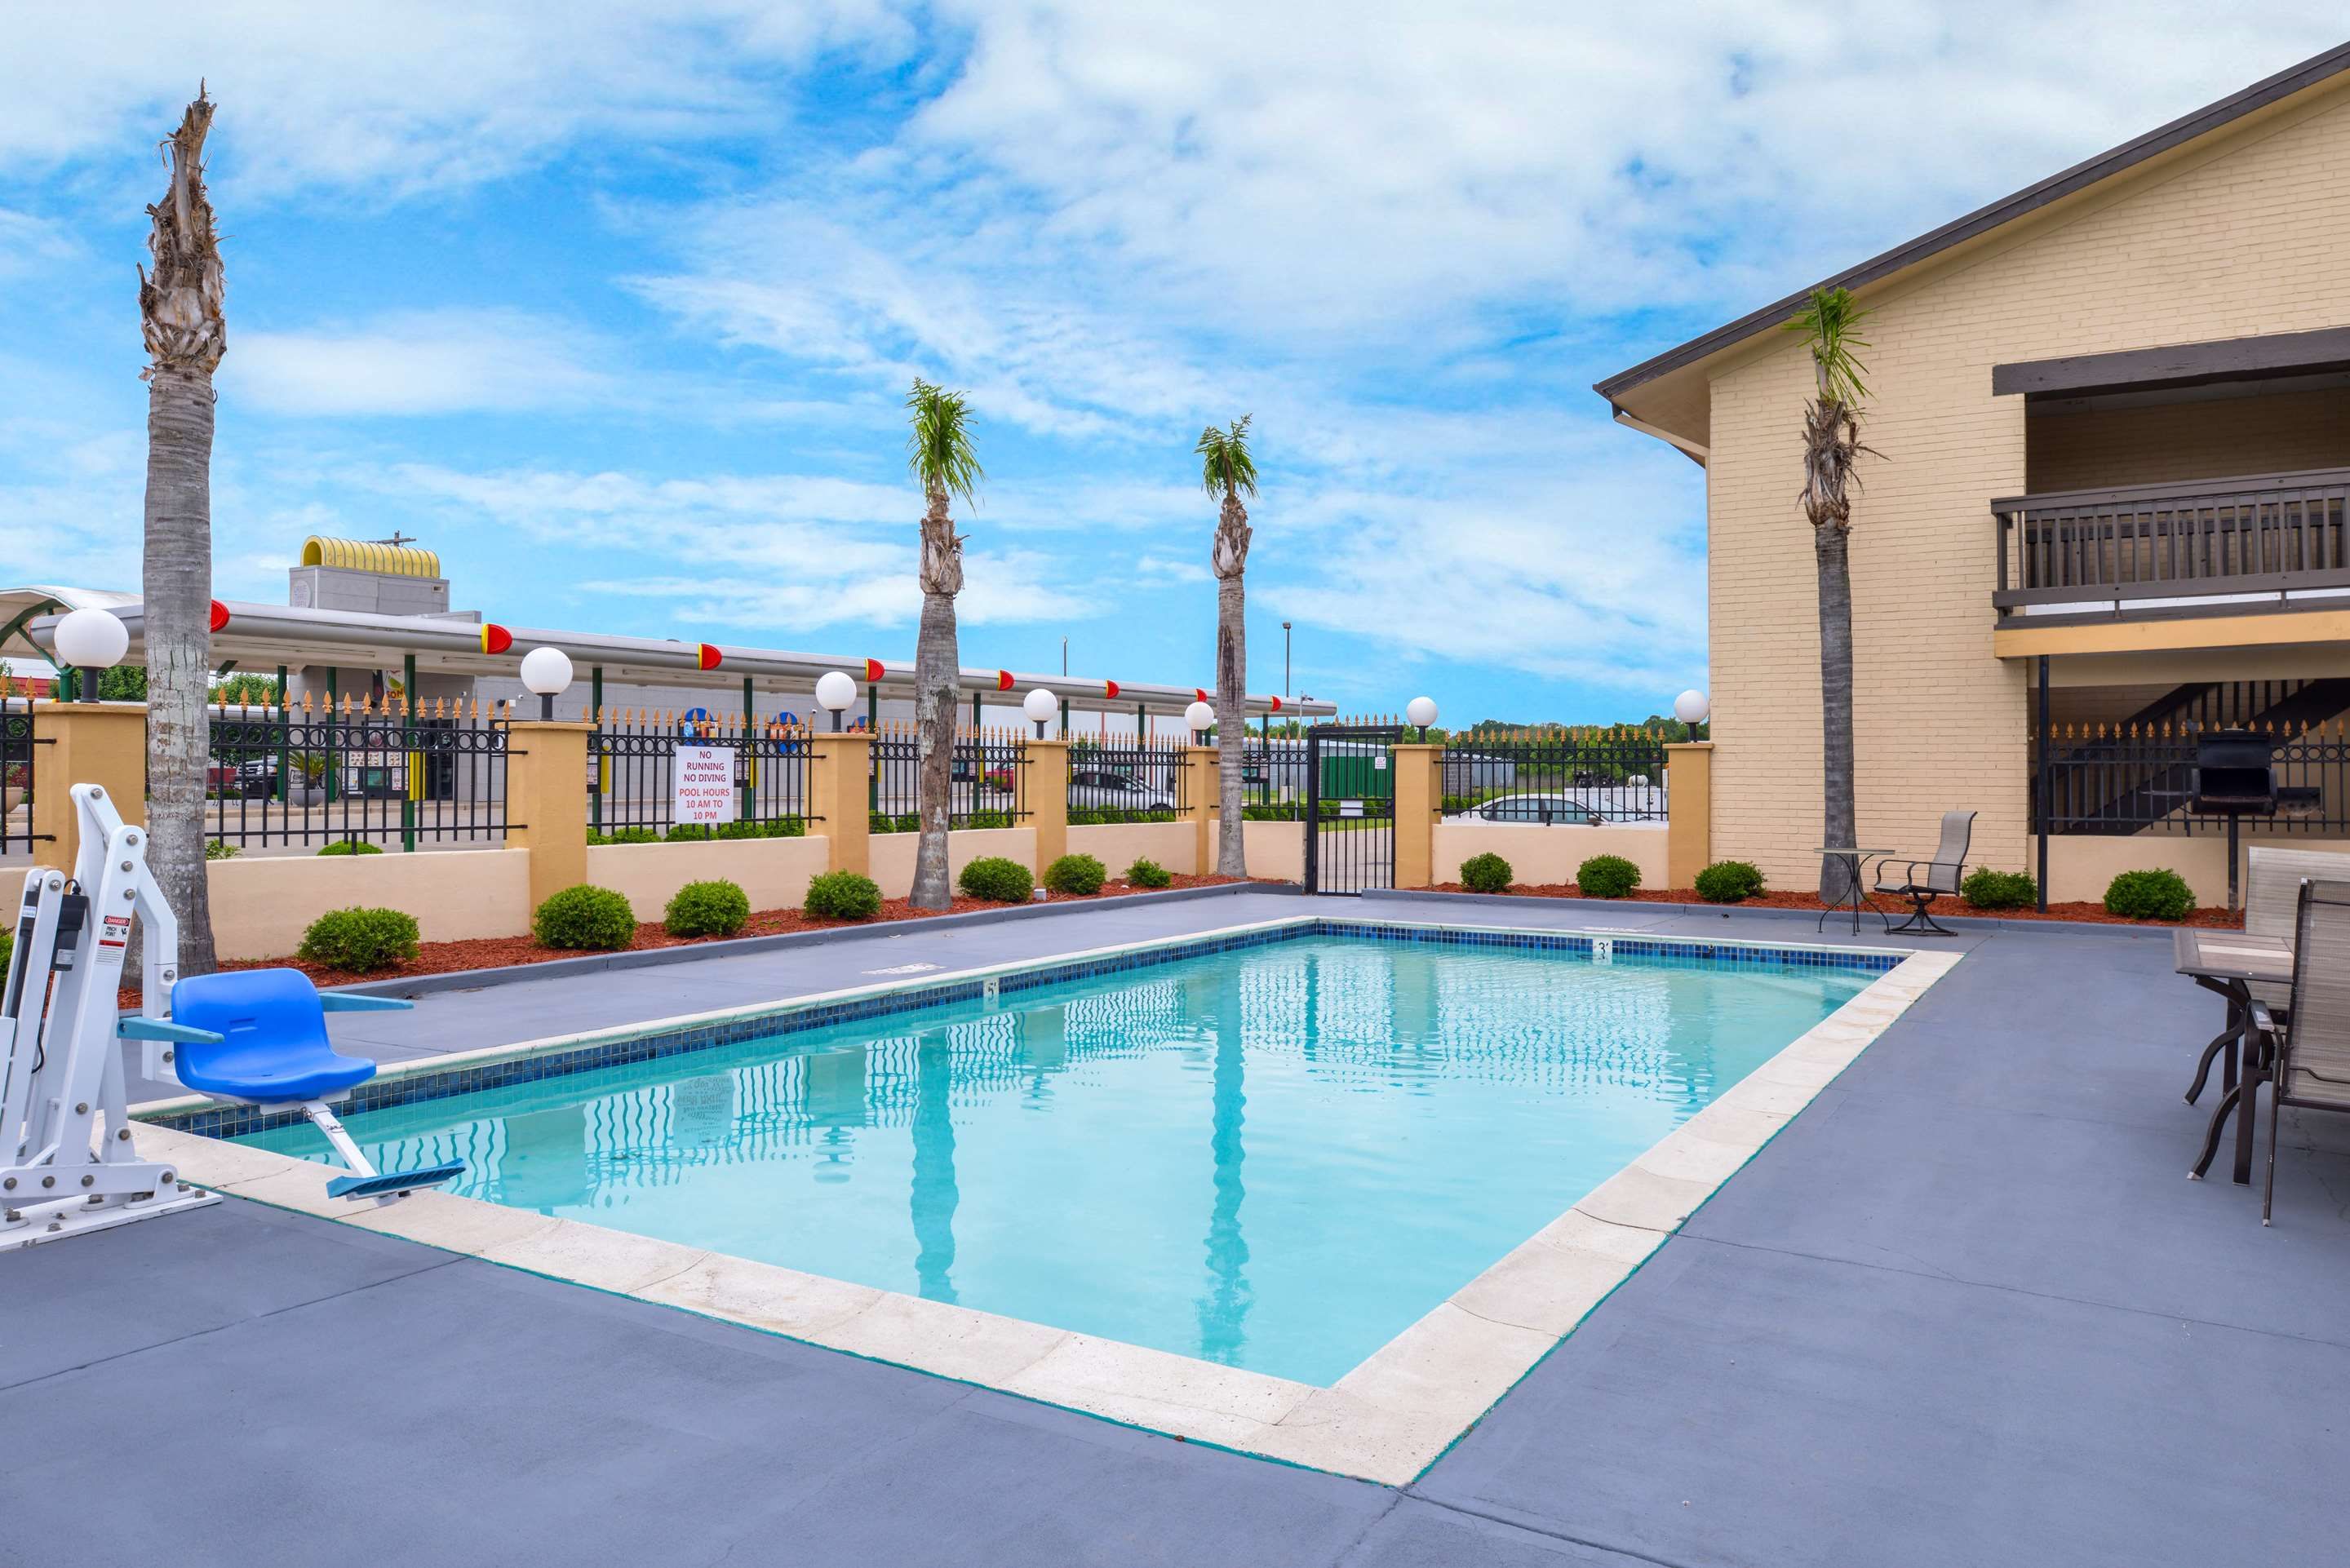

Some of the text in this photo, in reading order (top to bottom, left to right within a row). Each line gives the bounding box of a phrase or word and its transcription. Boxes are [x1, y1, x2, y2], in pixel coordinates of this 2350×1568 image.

[699, 751, 712, 759] NO
[687, 762, 725, 770] RUNNING
[684, 774, 726, 782] NO DIVING
[679, 788, 729, 796] POOL HOURS
[686, 800, 695, 808] 10
[694, 812, 703, 820] 10
